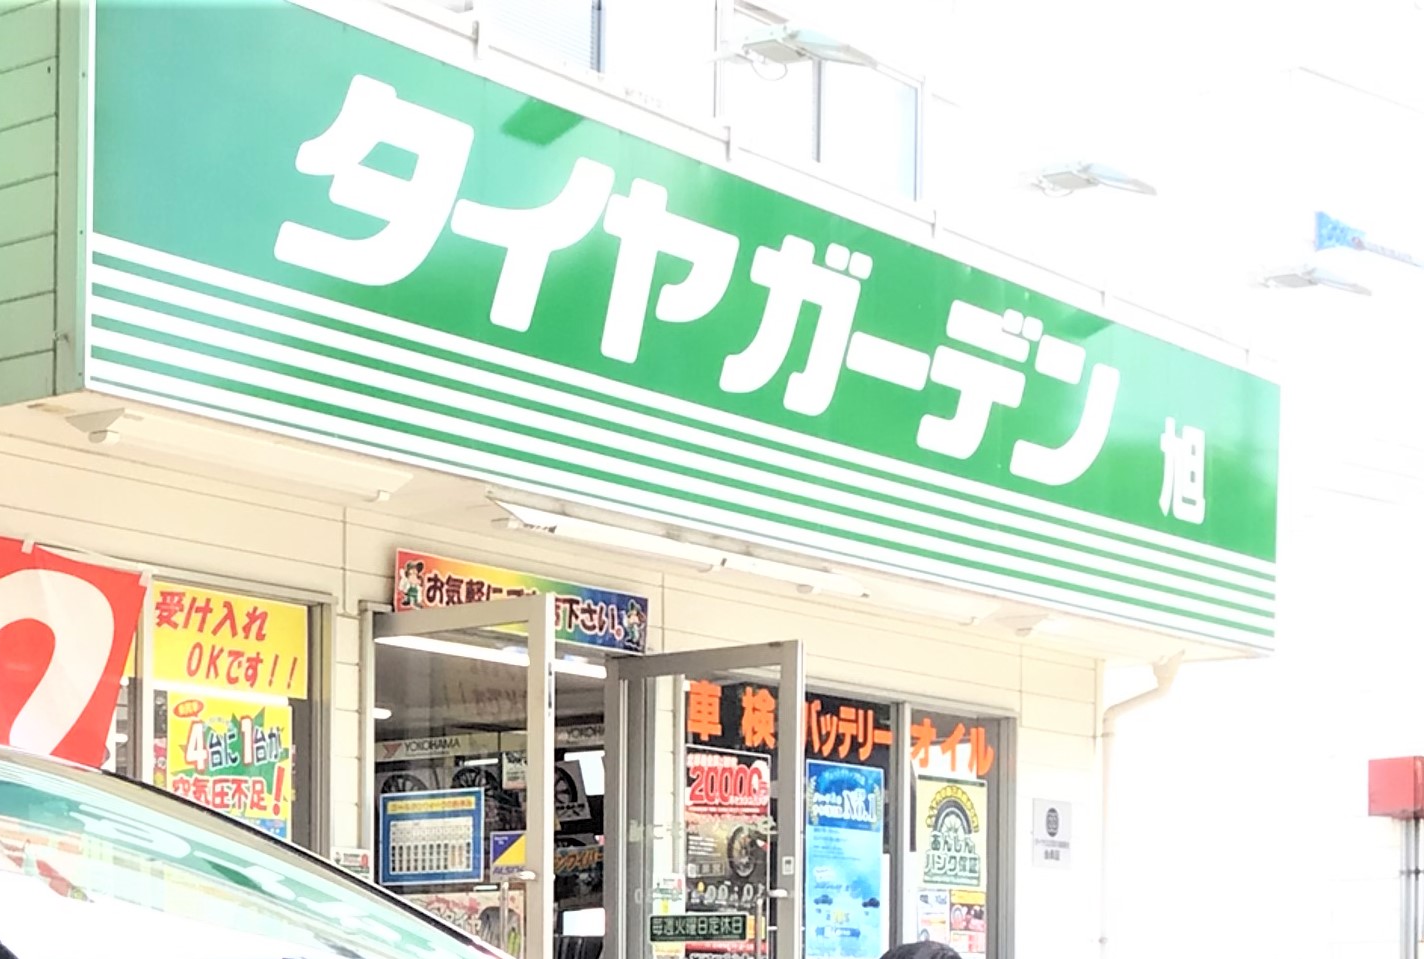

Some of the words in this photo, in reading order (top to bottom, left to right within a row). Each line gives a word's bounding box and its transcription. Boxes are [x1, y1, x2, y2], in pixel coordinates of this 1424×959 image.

[274, 74, 1119, 485] タイヤガーデン
[1160, 416, 1205, 524] 旭
[155, 591, 268, 641] 受け入れ
[185, 714, 285, 771] 4台に1台が
[404, 738, 460, 752] YOKOHAMA
[565, 727, 605, 739] YOKOH
[805, 700, 893, 761] バッテリー
[910, 718, 994, 775] オイル
[173, 765, 285, 815] 空気圧不足!
[931, 834, 975, 854] あんしん
[652, 917, 743, 936] 毎週火曜日定休日
